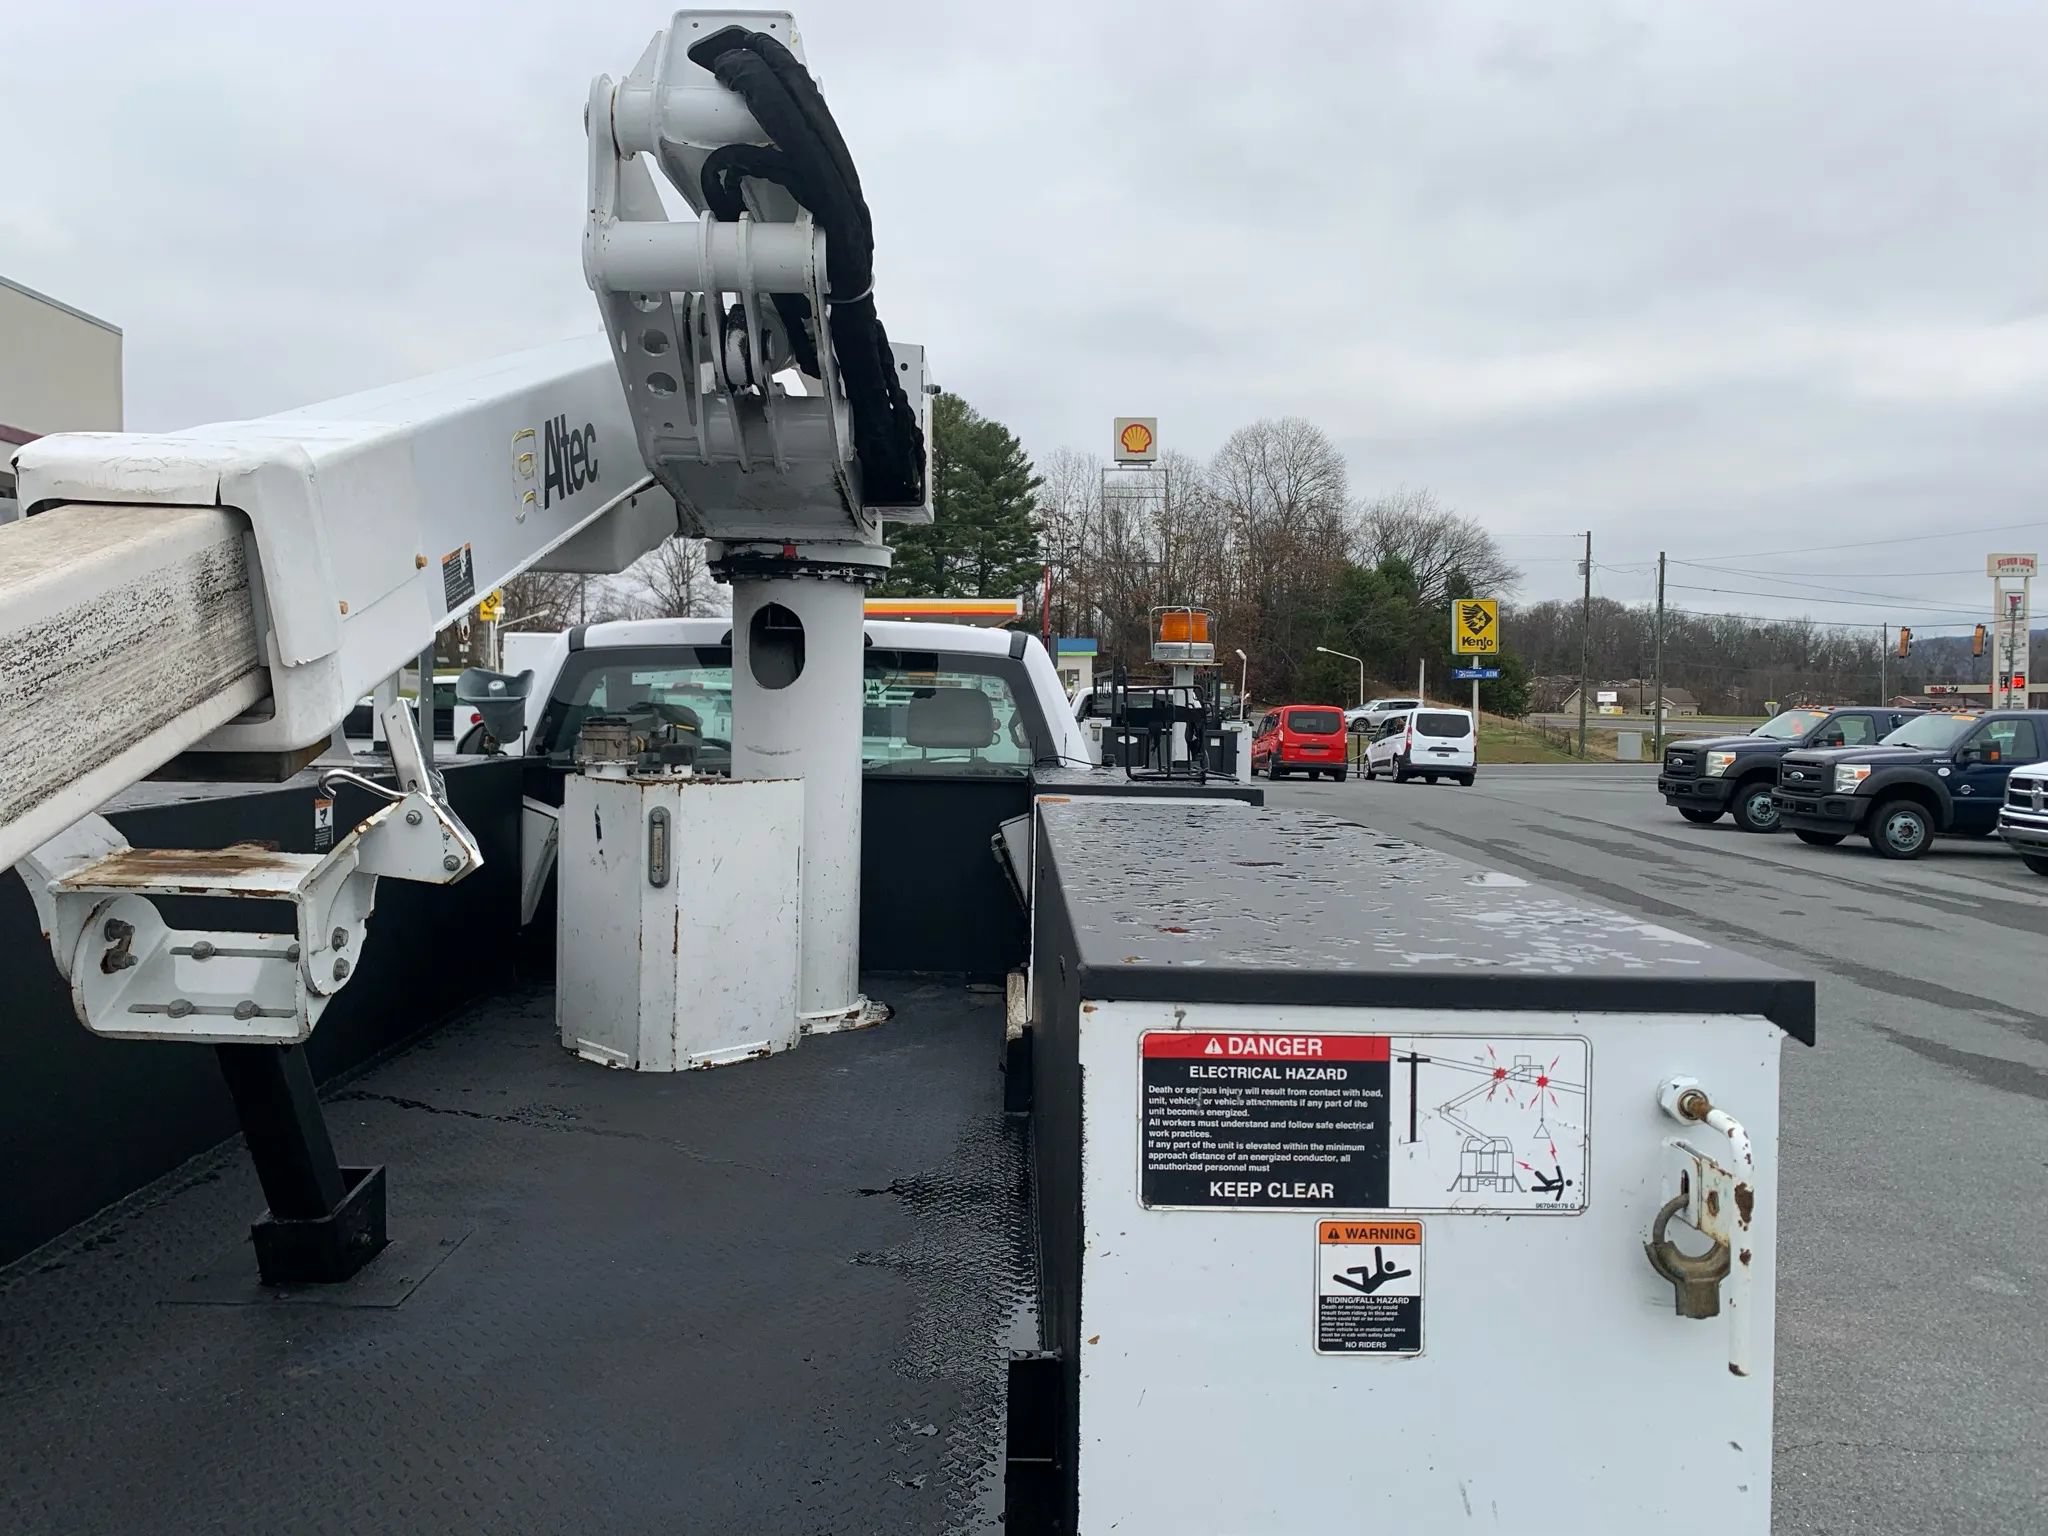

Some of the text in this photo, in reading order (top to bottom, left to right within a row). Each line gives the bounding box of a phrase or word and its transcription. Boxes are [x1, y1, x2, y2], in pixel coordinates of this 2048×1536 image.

[545, 414, 598, 510] Altec
[1228, 1036, 1322, 1056] DANGER
[1190, 1066, 1348, 1080] ELECTRICAL HAZARD
[1148, 1086, 1173, 1094] Death
[1218, 1086, 1242, 1096] injury
[1261, 1087, 1286, 1095] result
[1287, 1088, 1307, 1096] from
[1362, 1089, 1383, 1098] load,
[1148, 1097, 1167, 1106] unit,
[1246, 1099, 1298, 1107] attachments
[1325, 1100, 1342, 1108] part
[1148, 1107, 1165, 1115] unit
[1206, 1108, 1250, 1118] energized.
[1149, 1118, 1160, 1126] All
[1315, 1121, 1333, 1129] safe
[1335, 1122, 1374, 1130] electrical
[1171, 1130, 1212, 1138] practices.
[1156, 1142, 1171, 1150] any
[1173, 1142, 1190, 1150] part
[1148, 1152, 1188, 1160] approach
[1250, 1154, 1291, 1162] energized
[1293, 1154, 1338, 1162] conductor,
[1205, 1164, 1247, 1172] personnel
[1210, 1182, 1334, 1198] KEEP CLEAR
[1345, 1228, 1416, 1240] WARNING
